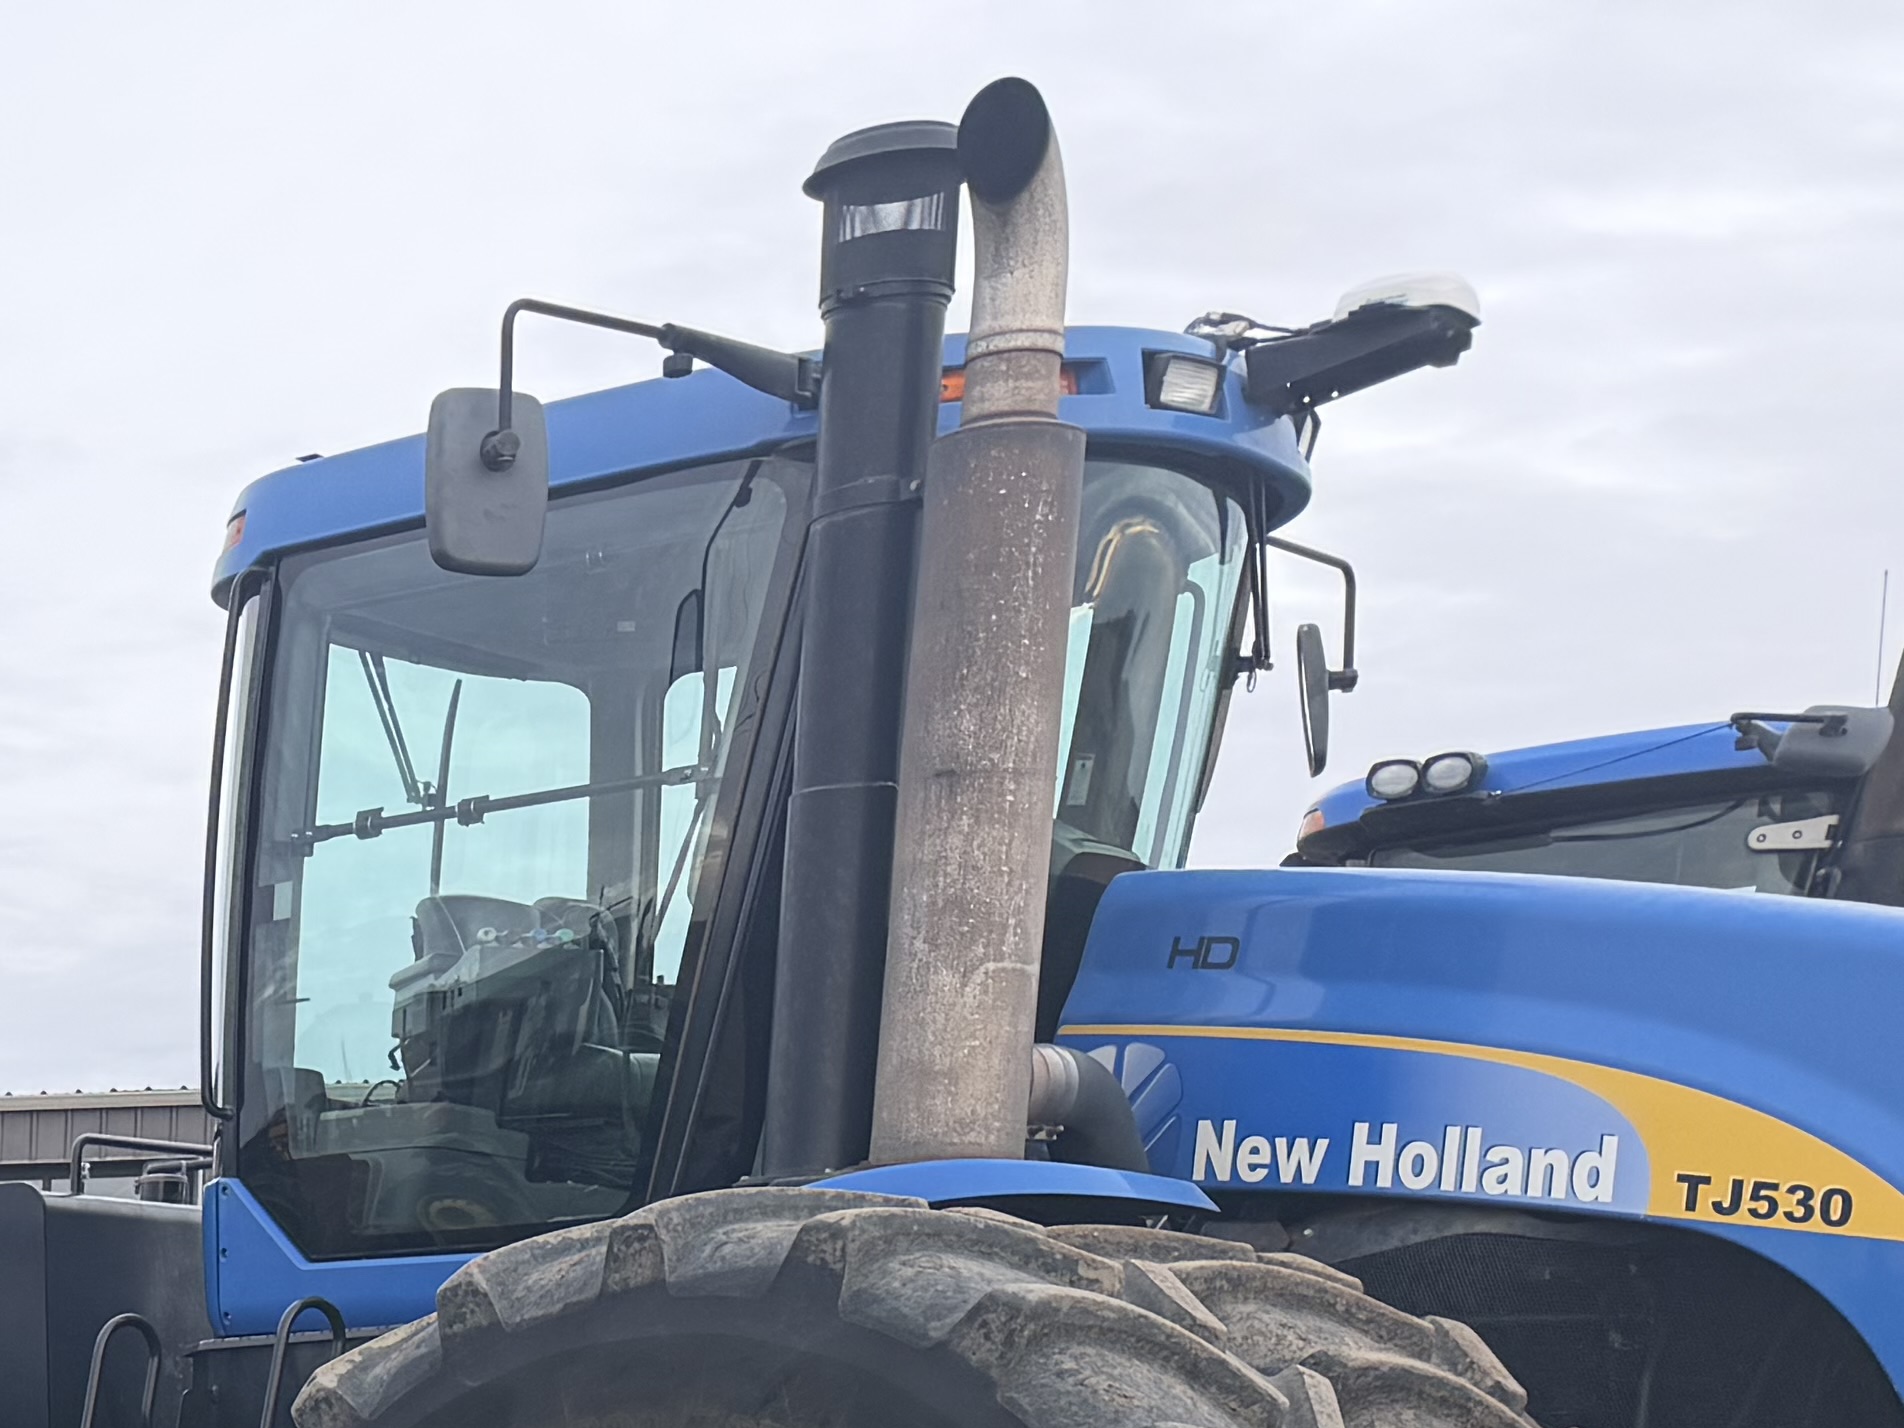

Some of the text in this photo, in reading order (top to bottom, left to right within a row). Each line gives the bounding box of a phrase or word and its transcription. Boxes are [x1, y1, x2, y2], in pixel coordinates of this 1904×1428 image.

[1167, 936, 1240, 970] HD
[1193, 1119, 1619, 1204] New Holland
[1676, 1173, 1854, 1228] TJ530
